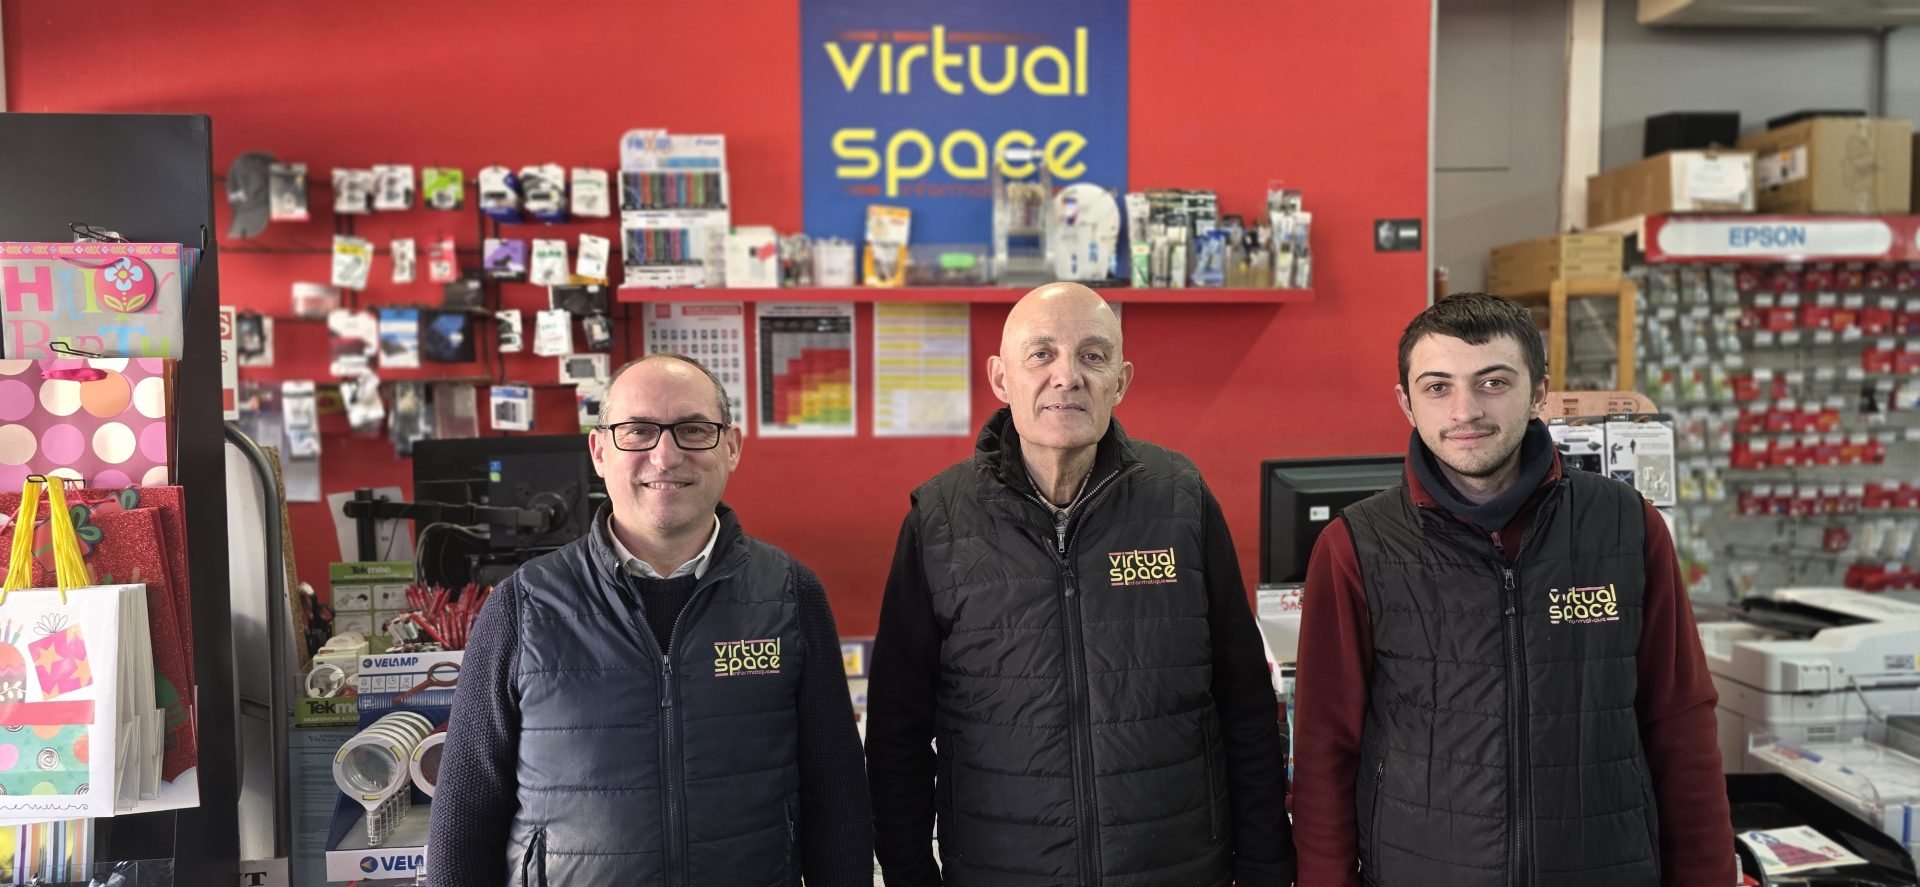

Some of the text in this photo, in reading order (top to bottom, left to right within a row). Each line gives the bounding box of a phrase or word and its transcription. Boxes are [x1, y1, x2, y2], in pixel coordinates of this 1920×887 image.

[824, 25, 1088, 95] virtual
[832, 128, 1088, 197] space
[1728, 226, 1806, 247] EPSON
[1109, 547, 1175, 568] virtual
[1109, 564, 1176, 586] space
[1549, 583, 1616, 605] virtual
[1549, 602, 1618, 621] space
[714, 637, 780, 658] virtual
[374, 656, 419, 668] VELAMP
[714, 655, 780, 676] space
[306, 700, 358, 715] Tekm
[380, 854, 424, 871] VELA
